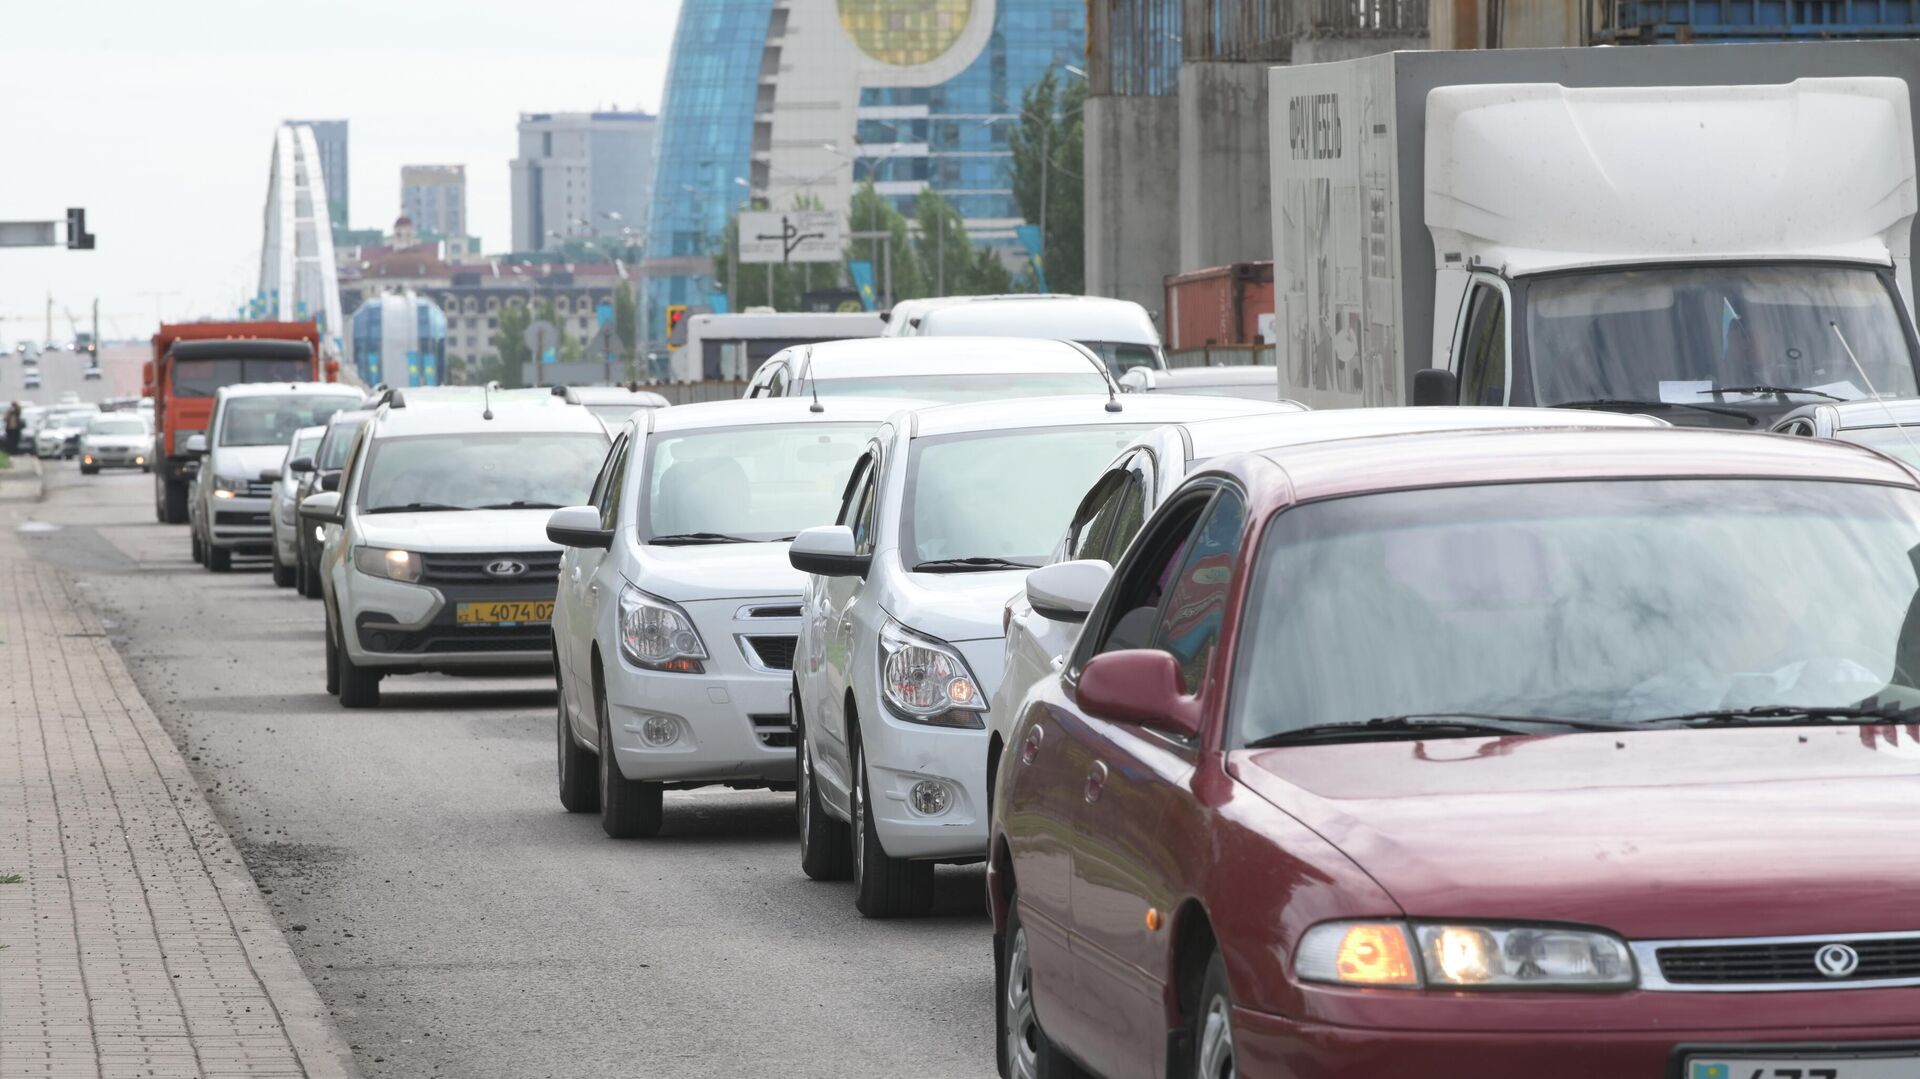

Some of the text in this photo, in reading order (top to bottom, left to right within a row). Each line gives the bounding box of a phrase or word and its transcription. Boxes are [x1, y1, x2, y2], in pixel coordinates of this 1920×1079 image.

[1289, 93, 1342, 161] ФРАУ МЕБЕЛЬ
[474, 608, 484, 621] L
[490, 604, 530, 621] 4074
